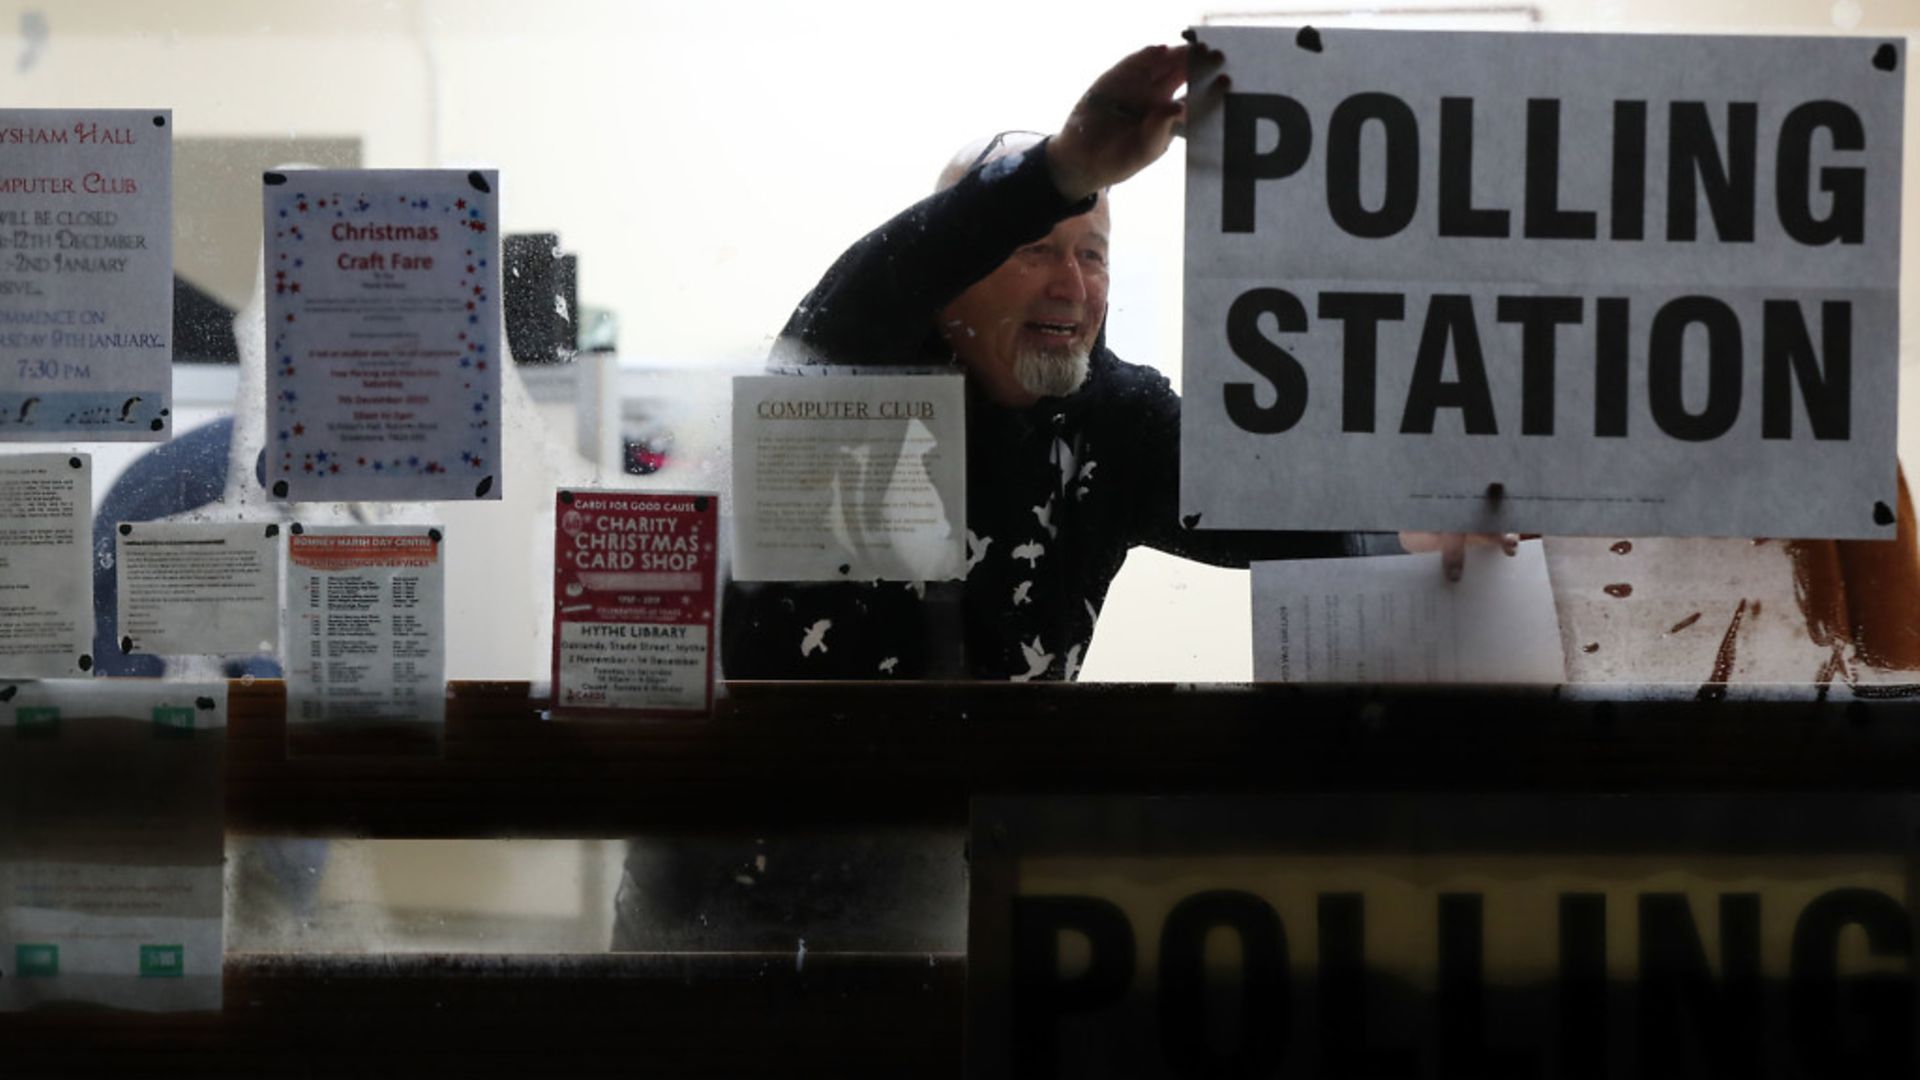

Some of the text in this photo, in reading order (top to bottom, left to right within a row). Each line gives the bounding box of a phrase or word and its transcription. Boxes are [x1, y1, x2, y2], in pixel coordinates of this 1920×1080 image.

[1221, 91, 1867, 245] POLLING
[34, 210, 52, 226] BE
[56, 210, 118, 226] CLOSED
[331, 222, 440, 241] Christmas
[337, 253, 433, 271] Craft Fare
[80, 310, 105, 325] ON
[17, 359, 58, 379] 7:30
[1223, 287, 1853, 443] STATION
[355, 395, 402, 404] December
[757, 401, 935, 418] COMPUTER CLUB
[574, 500, 607, 510] CARDS
[609, 501, 628, 510] FOR
[631, 502, 661, 511] GOOD
[597, 516, 678, 533] CHARITY
[373, 538, 393, 546] DAY
[395, 538, 430, 547] CENTRE
[575, 533, 699, 552] CHRISTMAS
[575, 552, 698, 571] CARD SHOP
[582, 626, 686, 639] HYTHE LIBRARY
[675, 644, 706, 654] Hythe
[577, 656, 627, 665] November
[650, 657, 699, 666] December
[1011, 887, 1914, 1080] POLLING
